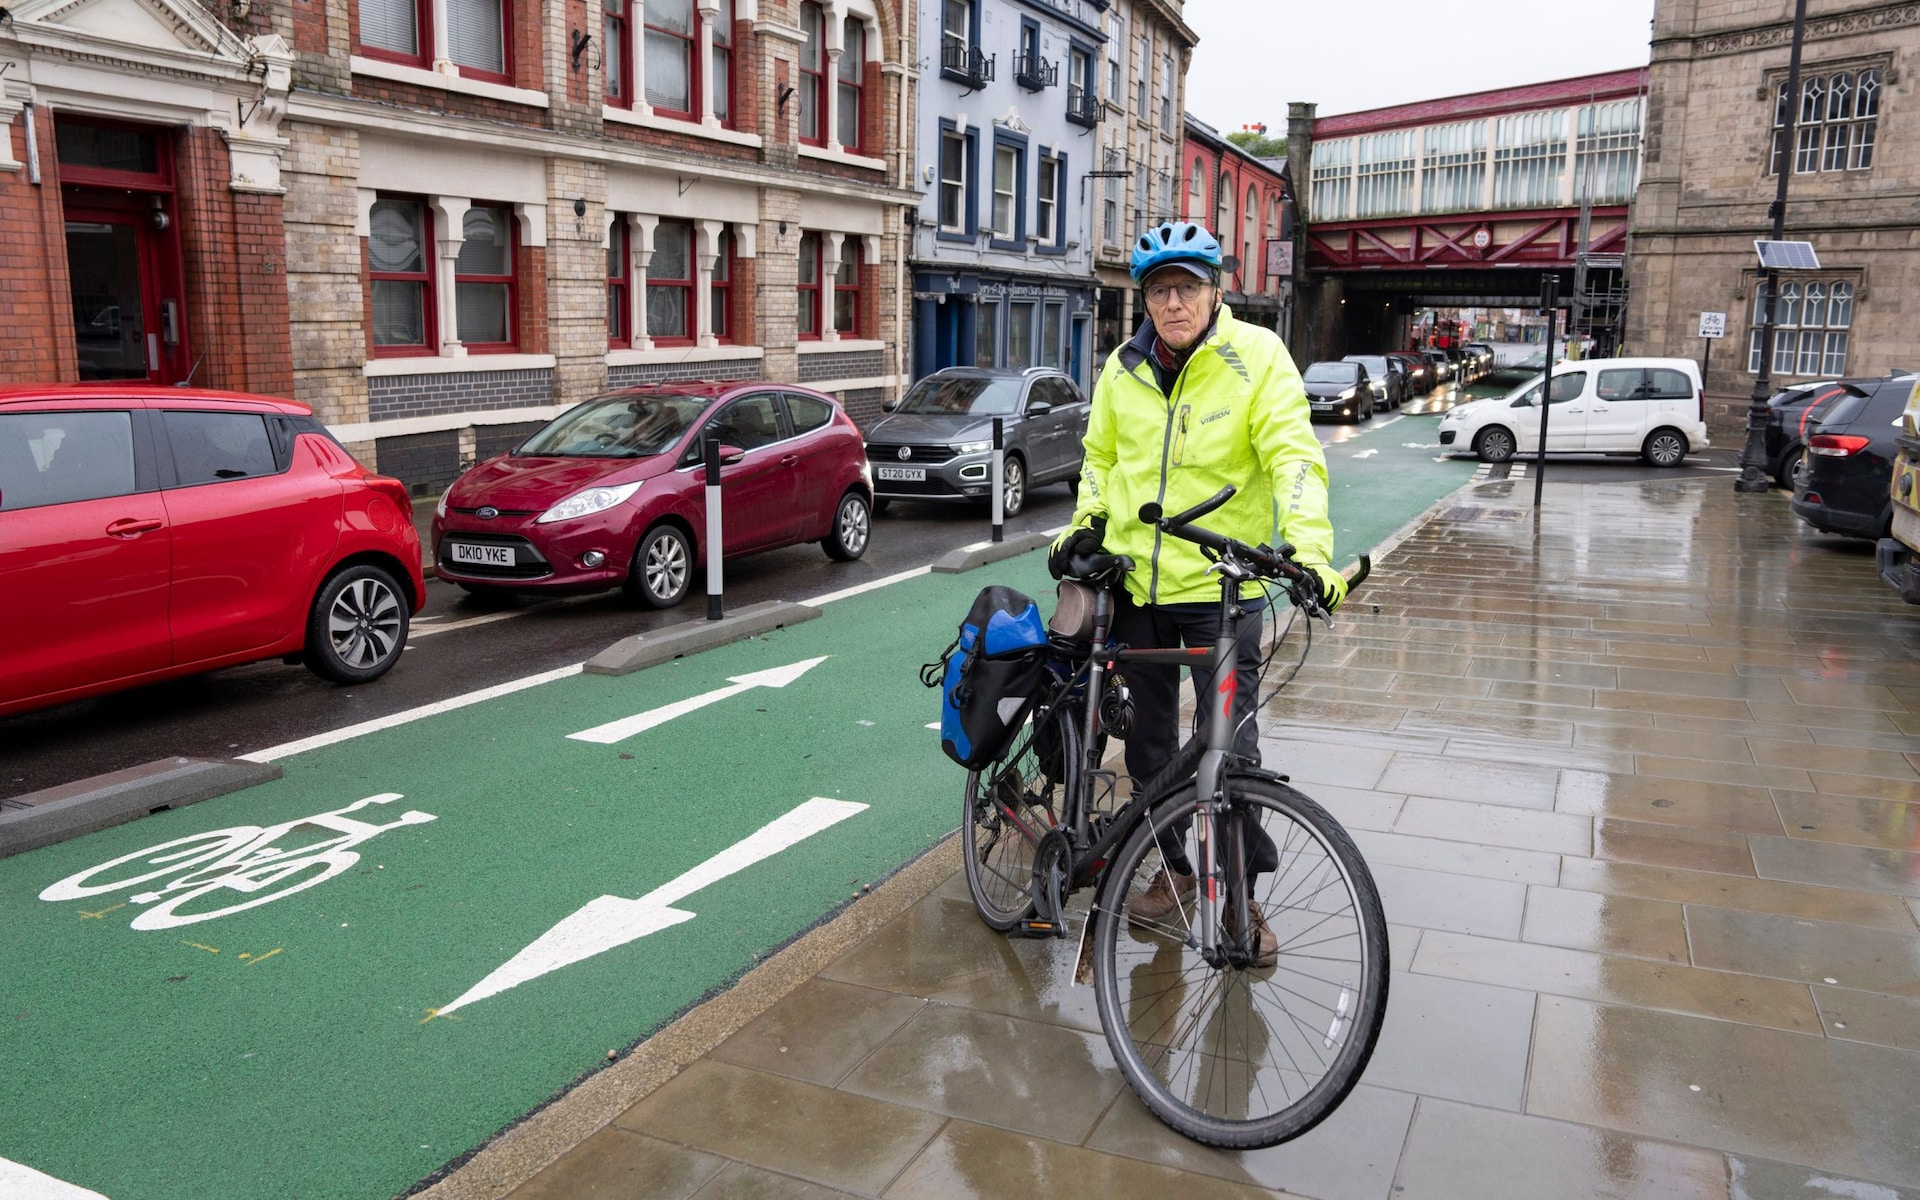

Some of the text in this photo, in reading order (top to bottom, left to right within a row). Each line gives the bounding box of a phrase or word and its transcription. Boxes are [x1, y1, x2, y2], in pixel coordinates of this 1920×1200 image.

[1200, 409, 1231, 425] VISION
[882, 469, 922, 479] ST20 GYX
[459, 545, 508, 562] DK10 YKE
